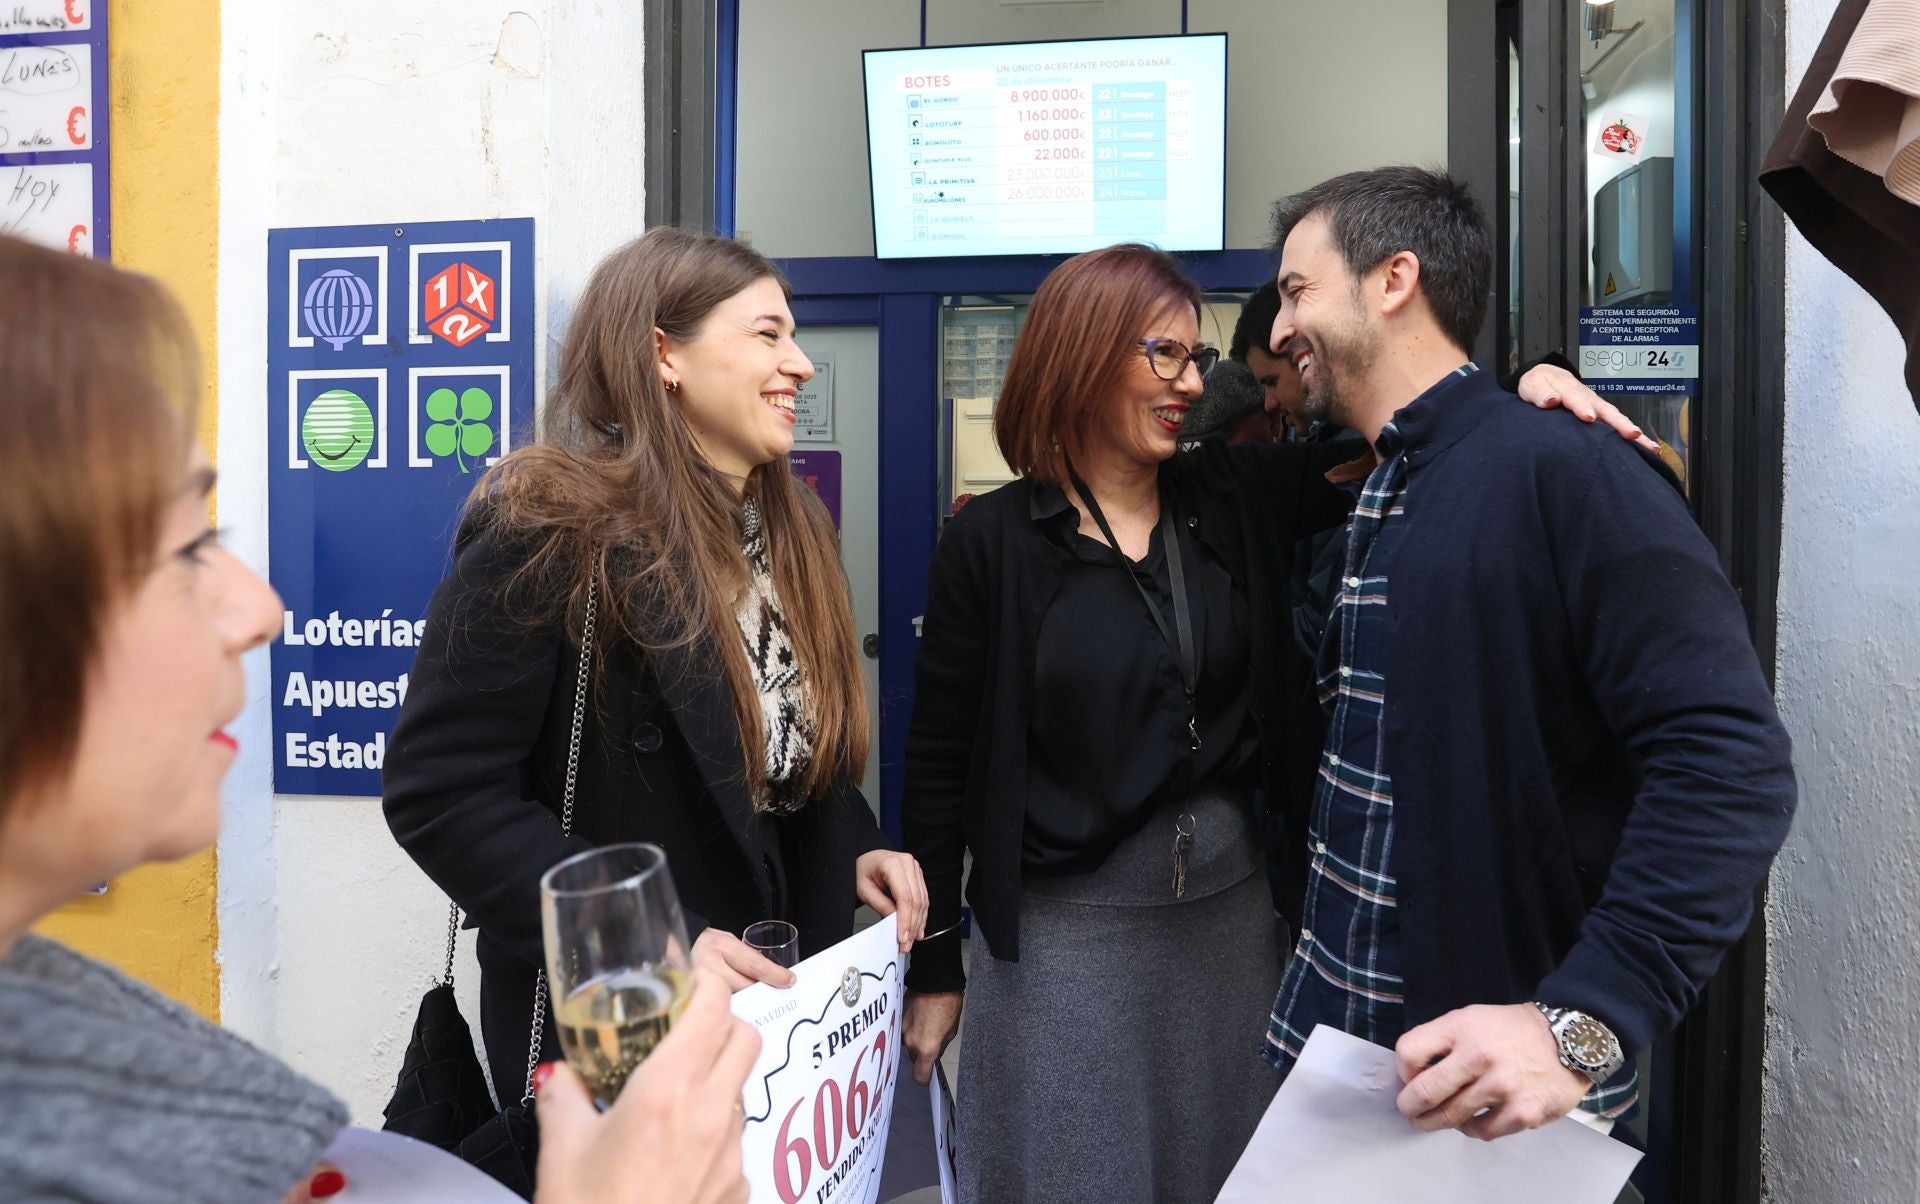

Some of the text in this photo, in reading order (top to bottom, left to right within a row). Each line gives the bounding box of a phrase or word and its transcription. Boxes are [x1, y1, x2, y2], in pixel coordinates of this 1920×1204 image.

[2, 52, 73, 85] LUNES
[904, 74, 951, 89] BOTES
[996, 66, 1010, 74] UN
[1044, 60, 1098, 72] ACERTANTE
[66, 105, 87, 146] €
[925, 120, 963, 128] LOTOTURF
[924, 138, 962, 146] BONOLOTO
[8, 167, 60, 213] HOY
[434, 269, 489, 314] 1 X
[442, 313, 484, 342] 2
[1585, 350, 1669, 372] segur24
[1626, 384, 1686, 393] www.segur24.es
[283, 608, 428, 647] Loterías
[283, 671, 410, 717] Apuest
[285, 732, 386, 770] Estad
[754, 999, 798, 1028] NAVIDAD
[812, 991, 889, 1070] 5 PREMIO
[816, 1137, 866, 1204] VENDIDO
